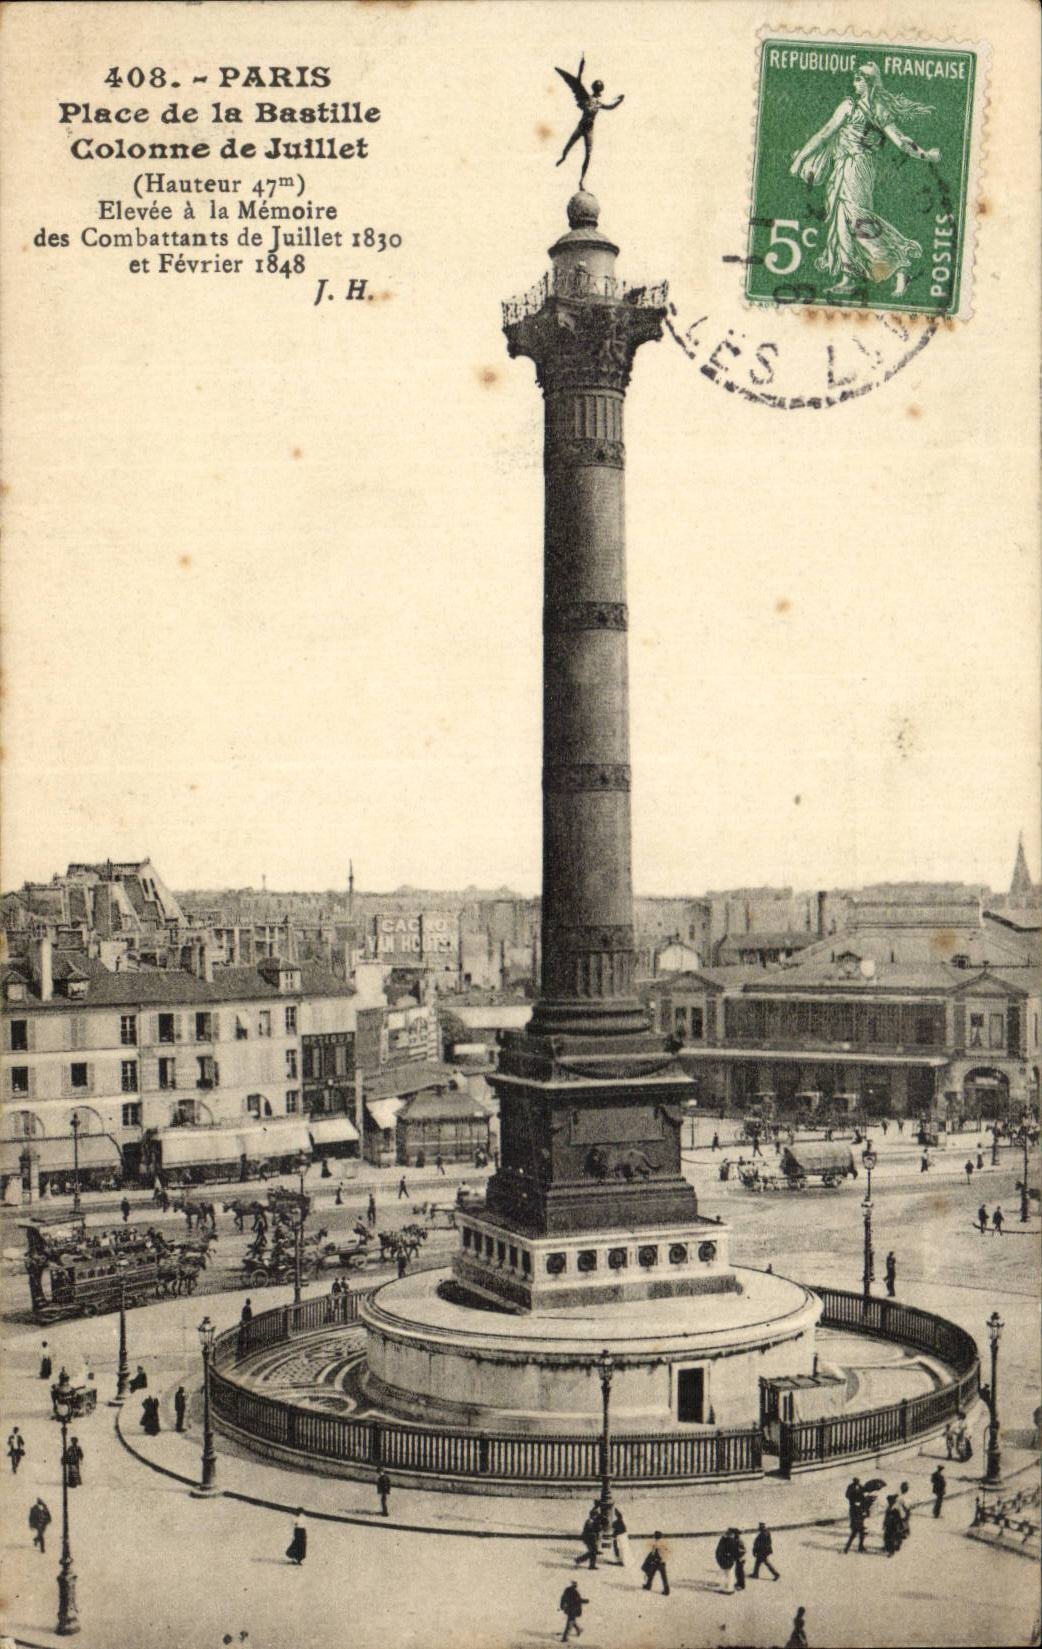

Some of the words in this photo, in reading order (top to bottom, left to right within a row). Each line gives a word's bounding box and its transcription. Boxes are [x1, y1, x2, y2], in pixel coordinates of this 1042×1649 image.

[769, 49, 857, 74] REPUBLIQUE
[884, 56, 966, 81] FRANÇAISE
[929, 213, 955, 298] POSTES
